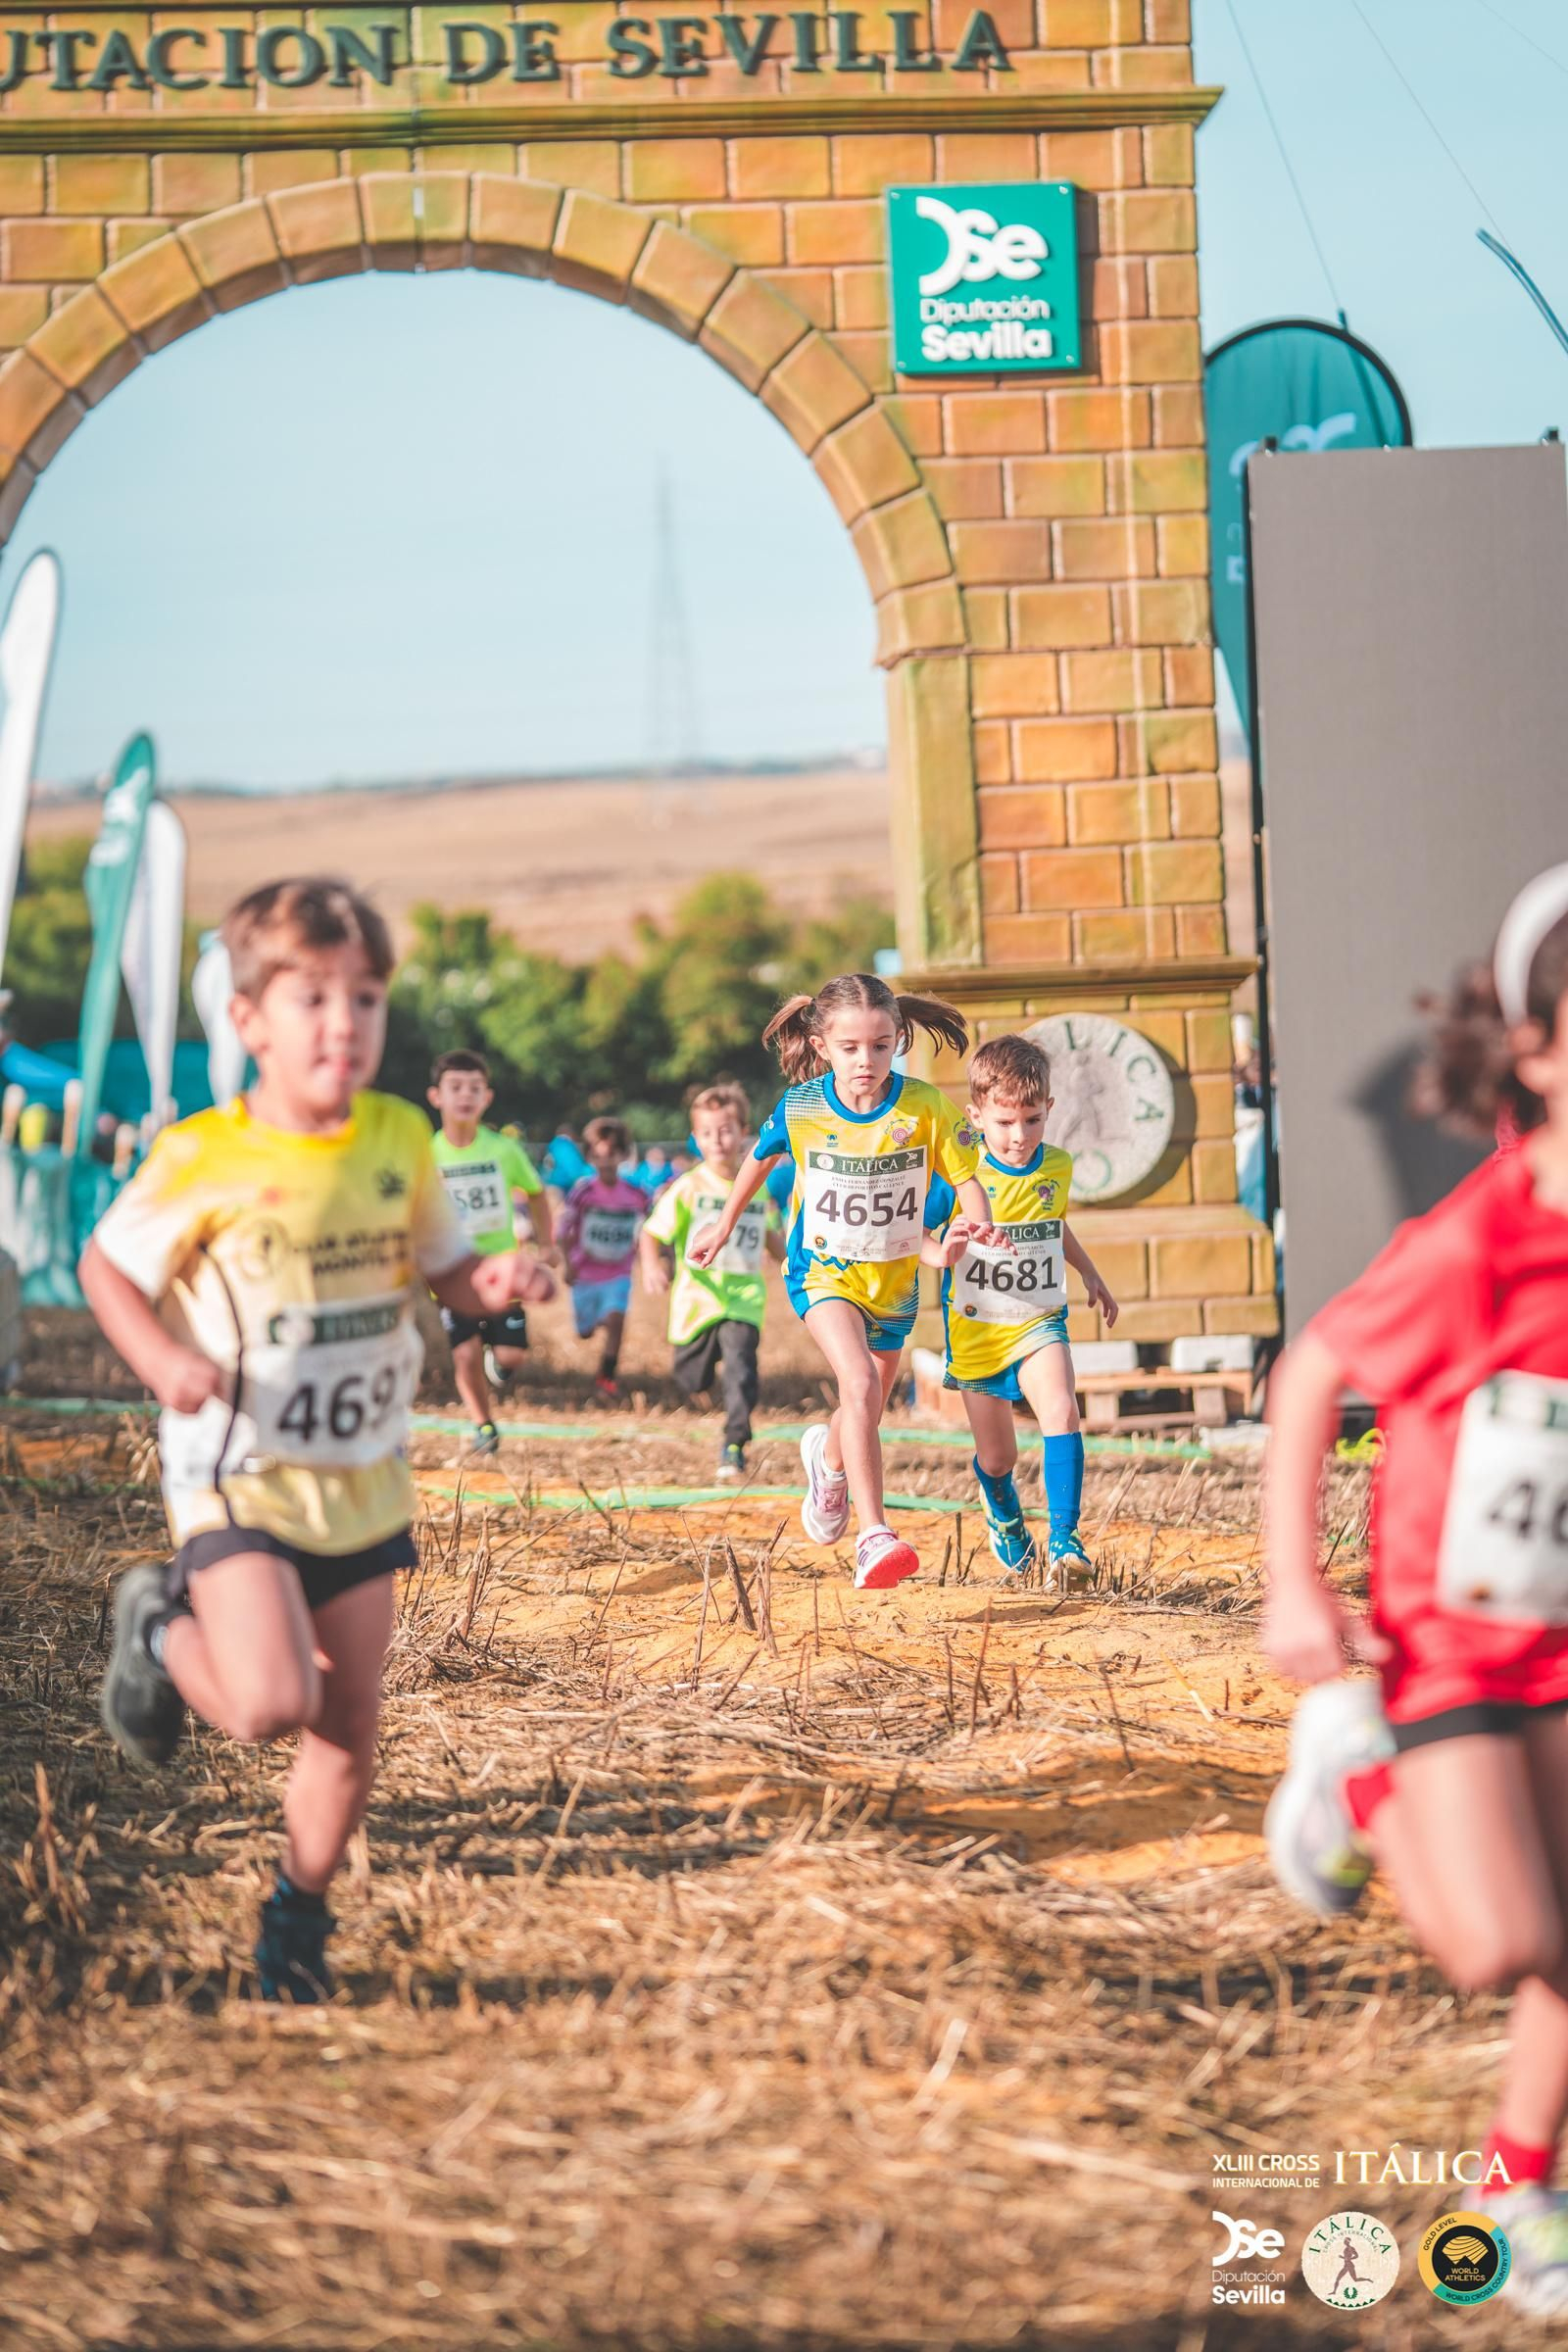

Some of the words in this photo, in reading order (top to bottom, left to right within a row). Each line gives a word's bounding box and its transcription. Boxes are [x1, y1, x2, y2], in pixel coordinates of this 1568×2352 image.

[441, 21, 562, 84] DE
[605, 8, 1016, 79] SEVILLA
[919, 295, 1051, 326] Diputación
[920, 321, 1054, 363] Sevilla
[841, 1157, 899, 1173] ITÁLICA
[815, 1187, 918, 1227] 4654
[965, 1256, 1058, 1293] 4681
